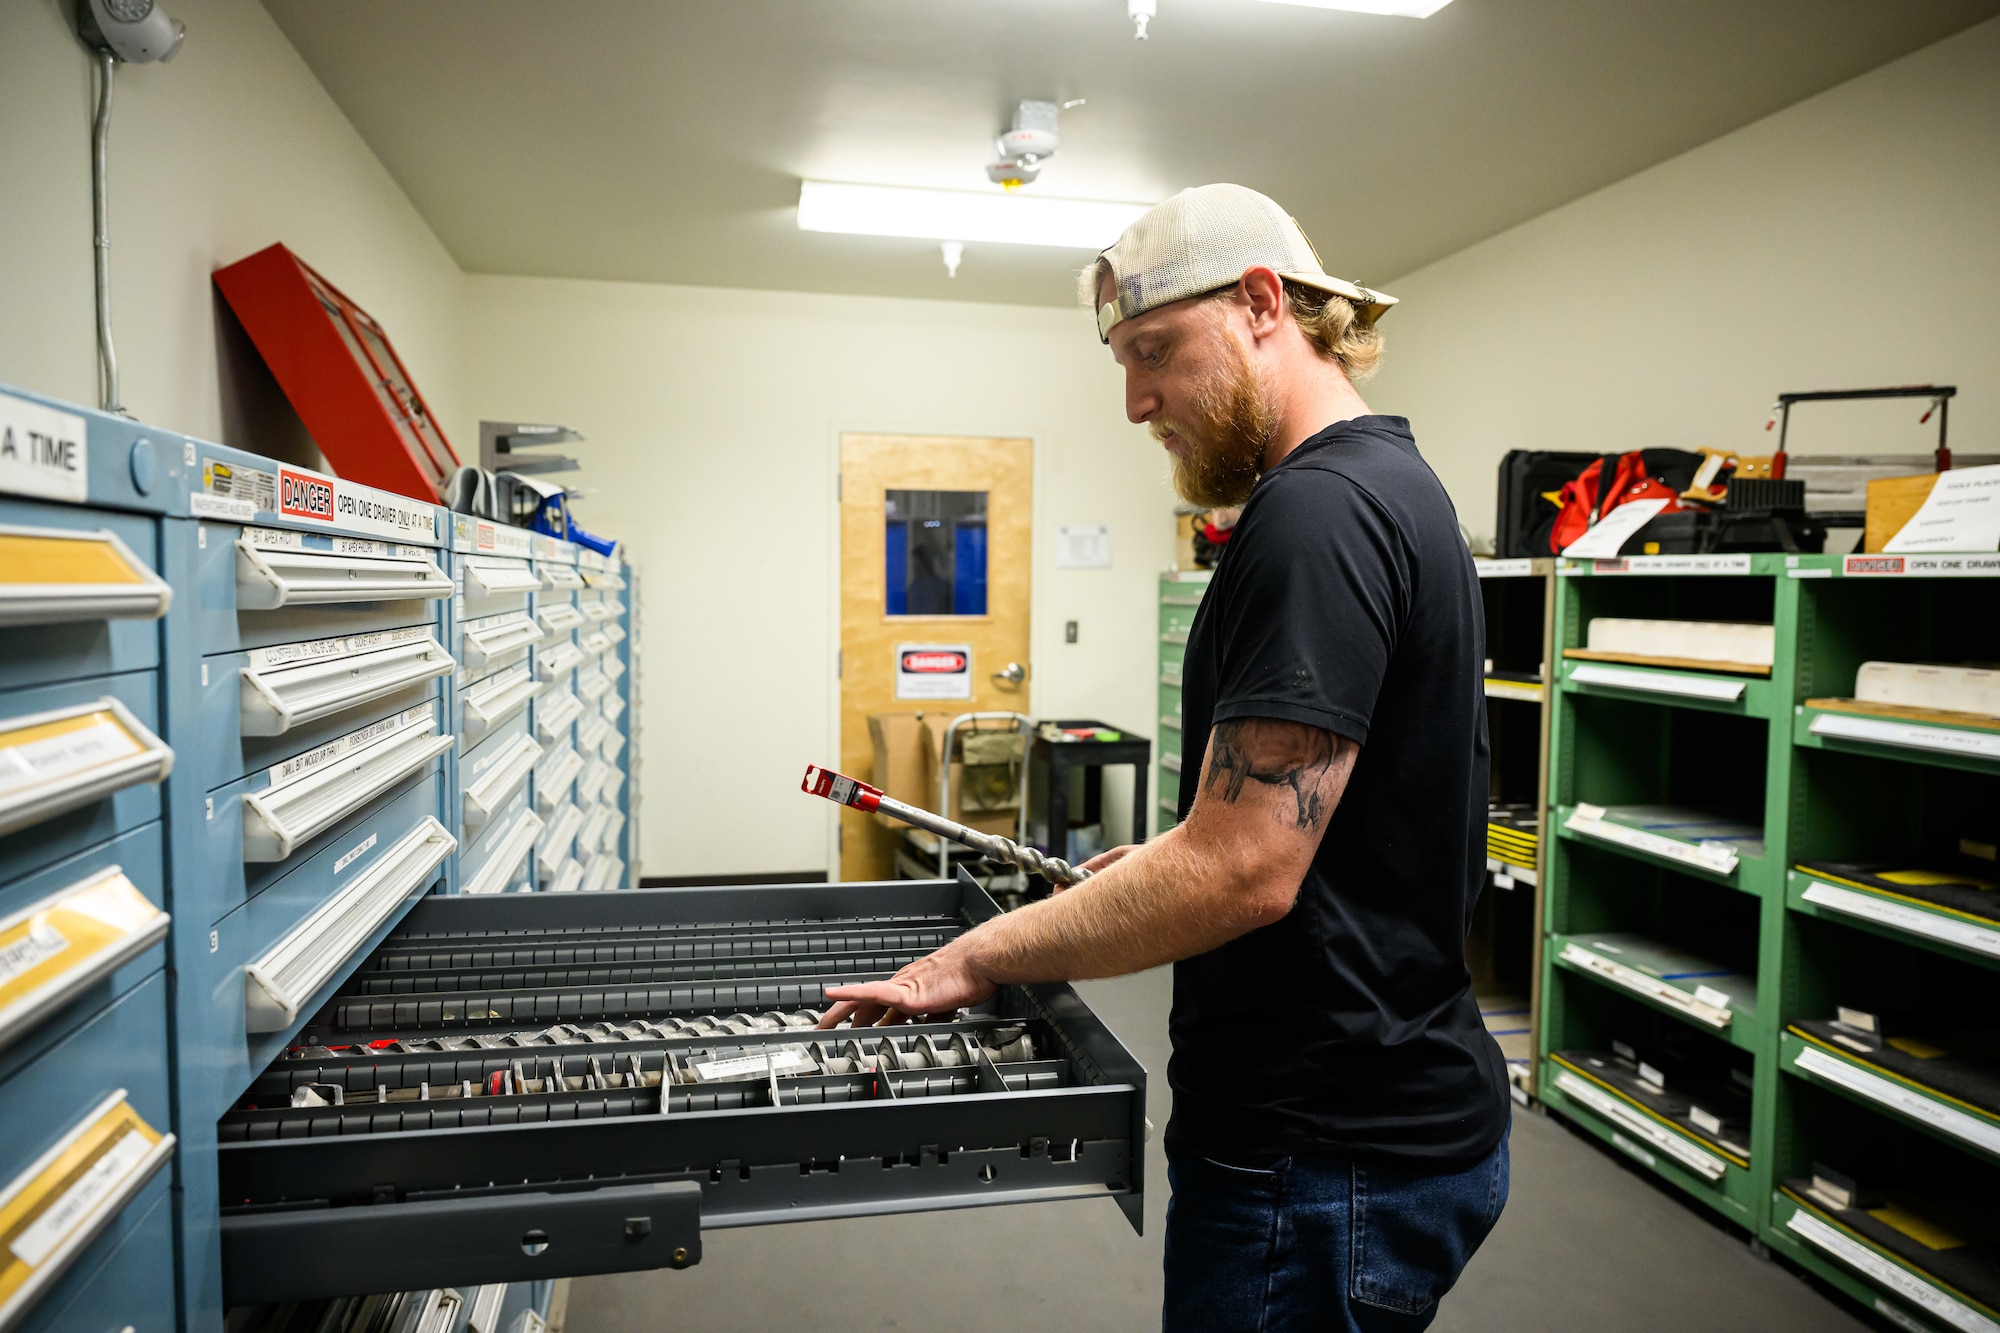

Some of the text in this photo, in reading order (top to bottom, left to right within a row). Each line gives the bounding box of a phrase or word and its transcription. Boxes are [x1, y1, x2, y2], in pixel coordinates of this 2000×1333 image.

[1, 426, 77, 471] A TIME
[283, 477, 331, 515] DANGER
[338, 494, 357, 516] OPEN
[359, 499, 371, 519] ONE
[374, 504, 396, 524] DRAWER
[398, 510, 410, 527] ONLY
[412, 513, 417, 528] AT
[423, 515, 433, 531] TIME
[1849, 559, 2000, 572] DANGER OPEN ONE DRAW
